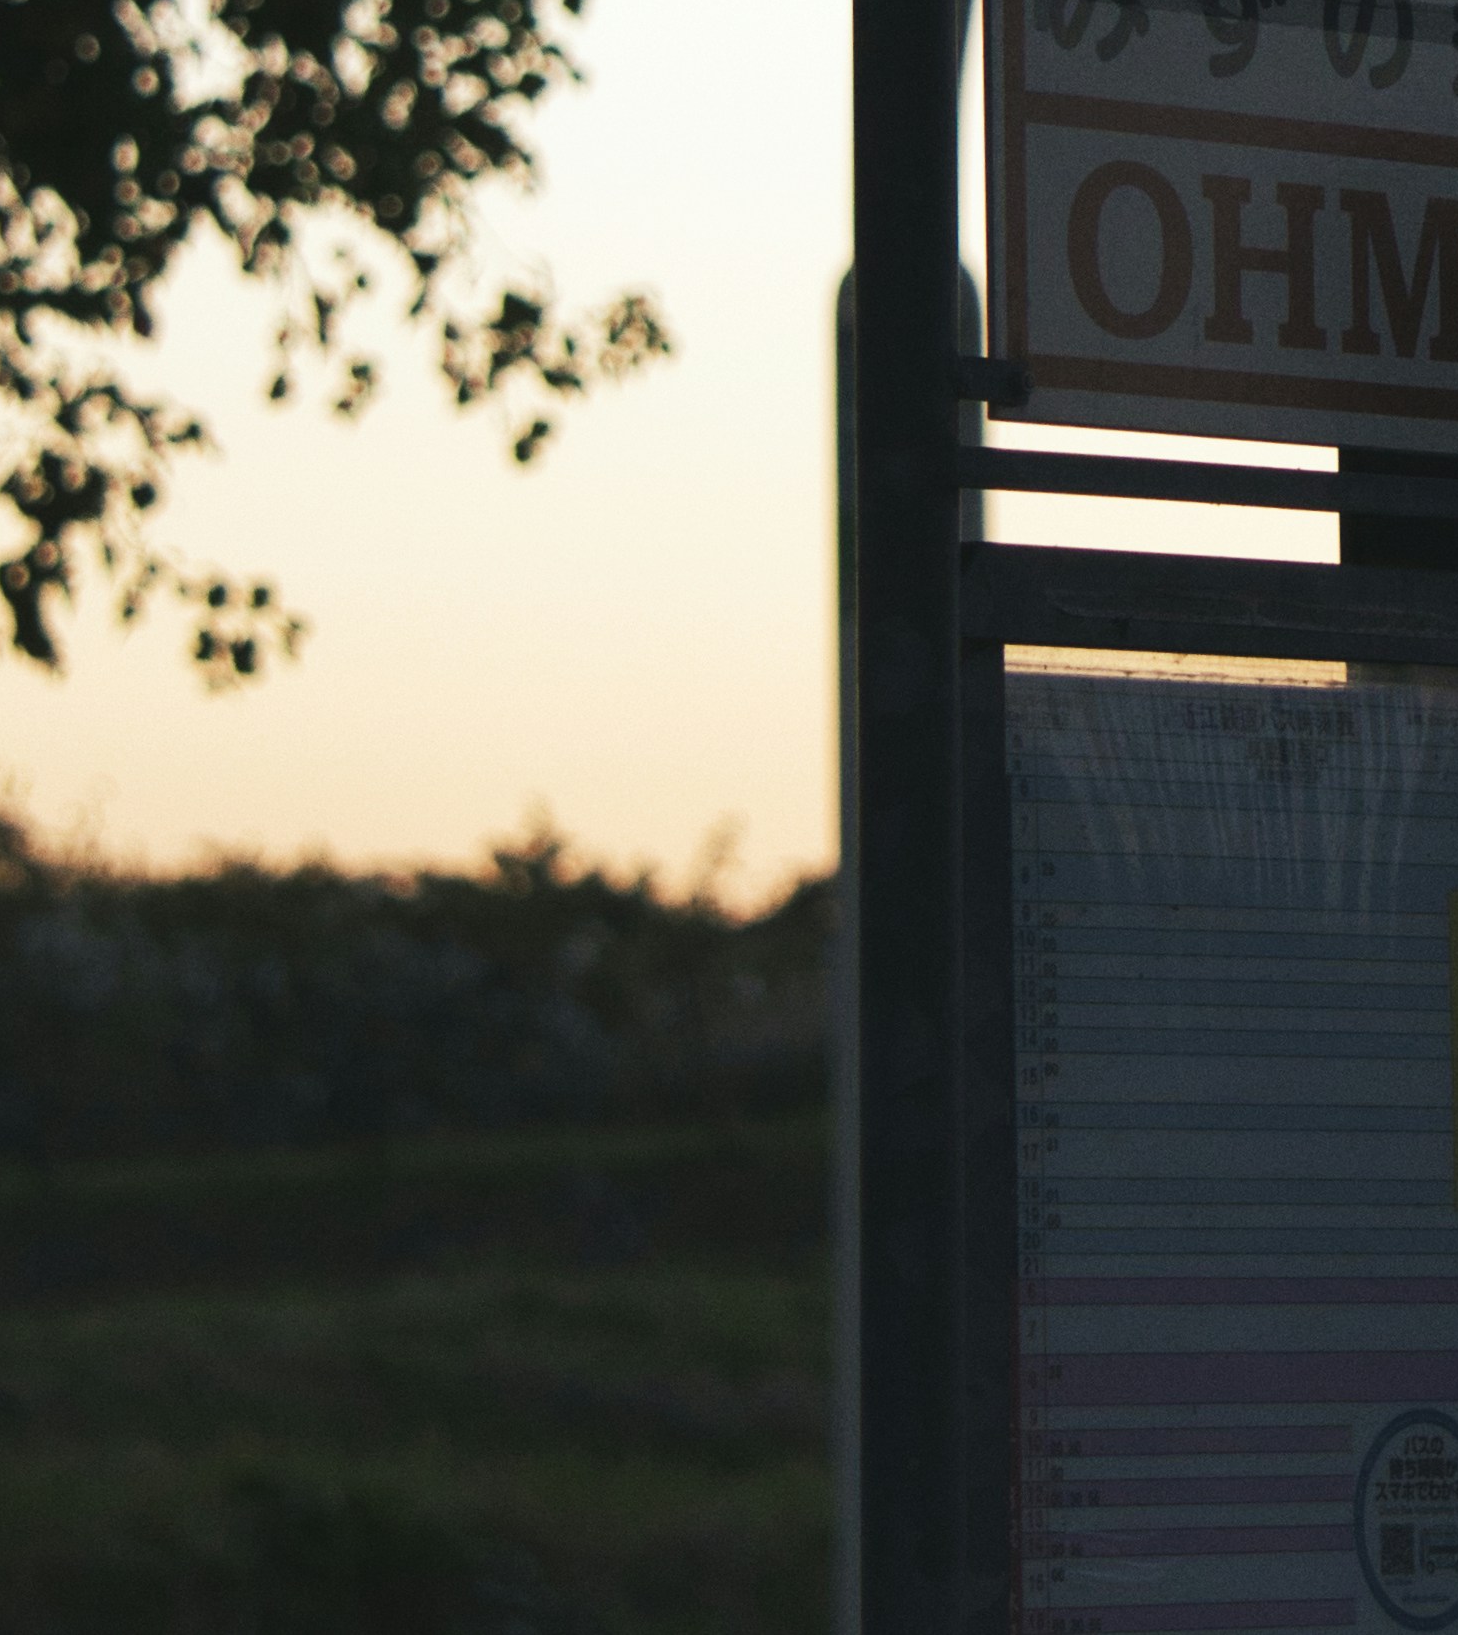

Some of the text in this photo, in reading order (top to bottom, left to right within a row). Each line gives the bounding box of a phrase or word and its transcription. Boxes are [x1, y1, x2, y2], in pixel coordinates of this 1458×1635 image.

[1020, 954, 1034, 972] 11
[1023, 1067, 1038, 1085] 15
[1023, 1105, 1039, 1124] 16
[1023, 1142, 1039, 1161] 17
[1023, 1231, 1041, 1251] 20
[1024, 1256, 1040, 1275] 21
[1403, 1436, 1444, 1455] バスの
[1389, 1457, 1458, 1479] 待ち時間が
